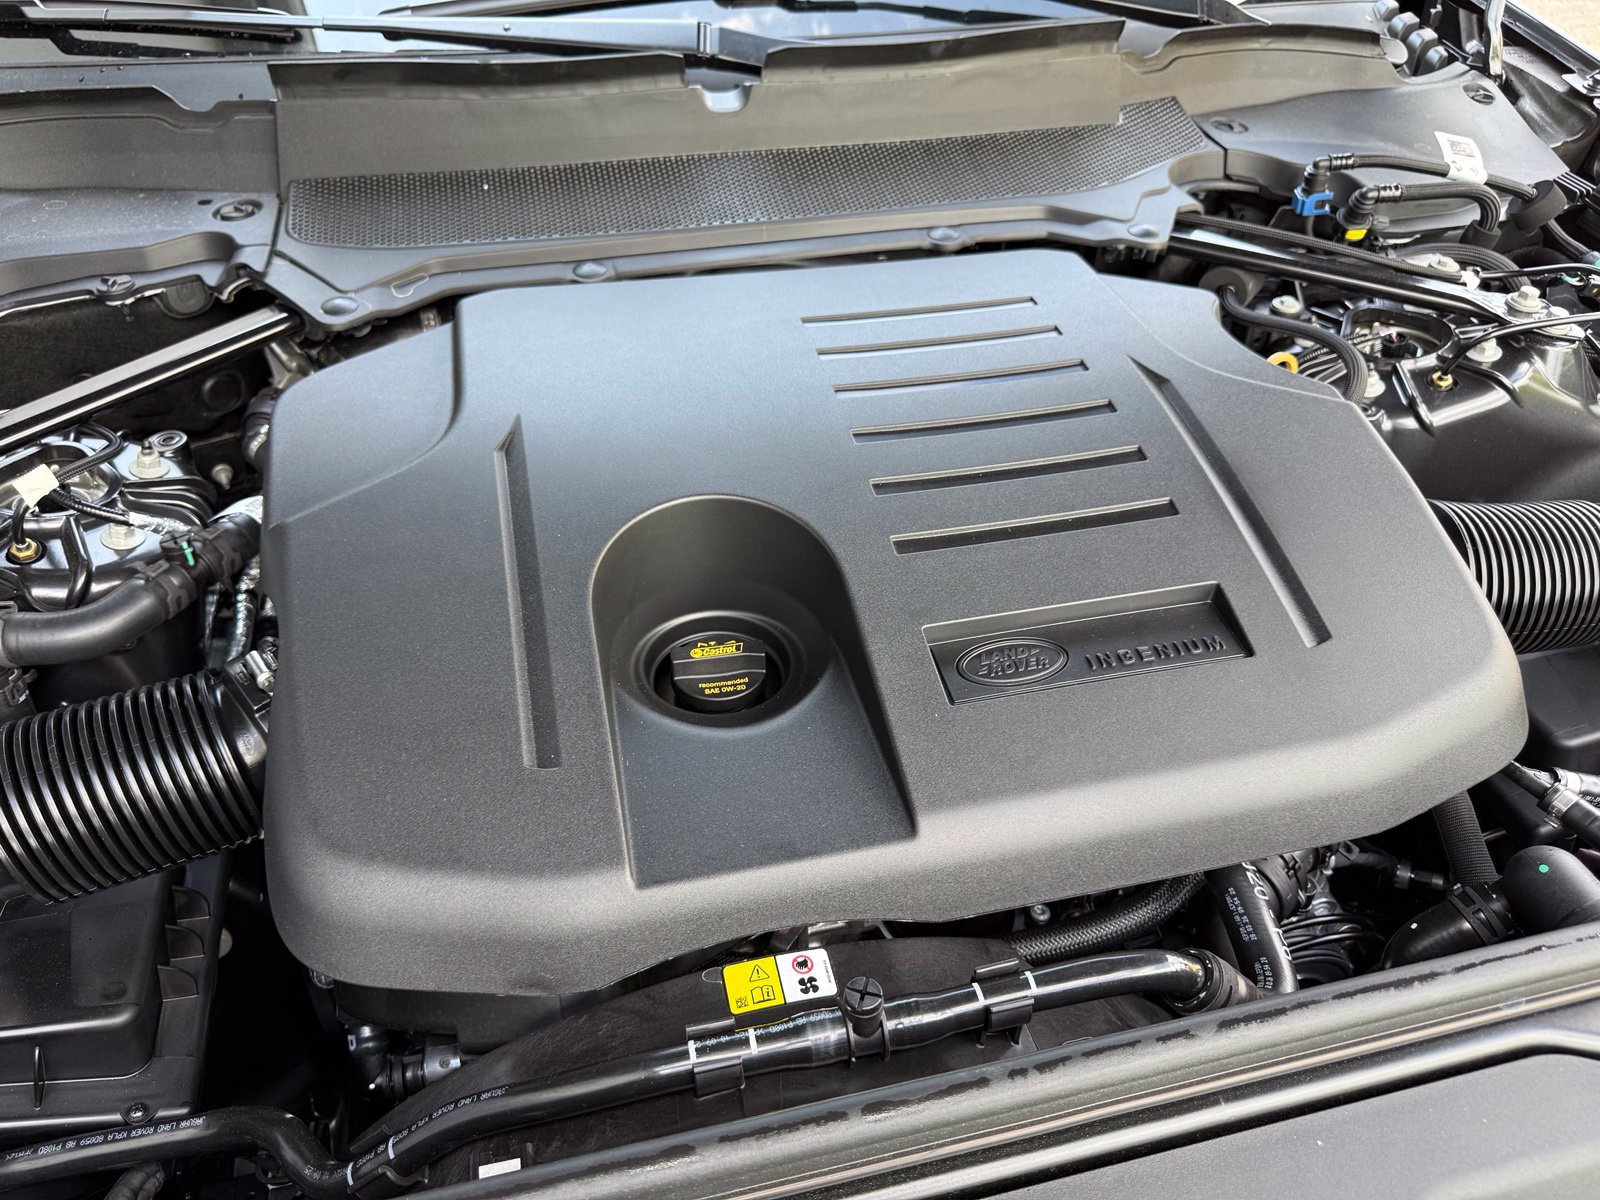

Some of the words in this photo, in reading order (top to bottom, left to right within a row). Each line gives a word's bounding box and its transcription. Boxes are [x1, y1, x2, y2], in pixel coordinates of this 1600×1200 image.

[703, 645, 737, 656] Castrol
[980, 647, 1029, 665] LAND
[1085, 635, 1227, 670] INGENIUM
[990, 656, 1050, 677] ROVER
[699, 677, 749, 688] recommended
[457, 1094, 478, 1107] LAND
[431, 1102, 456, 1119] ROVER
[157, 1121, 177, 1133] LAND
[179, 1115, 206, 1129] JAGUAR
[107, 1131, 128, 1141] KPLA
[131, 1126, 155, 1138] ROVER
